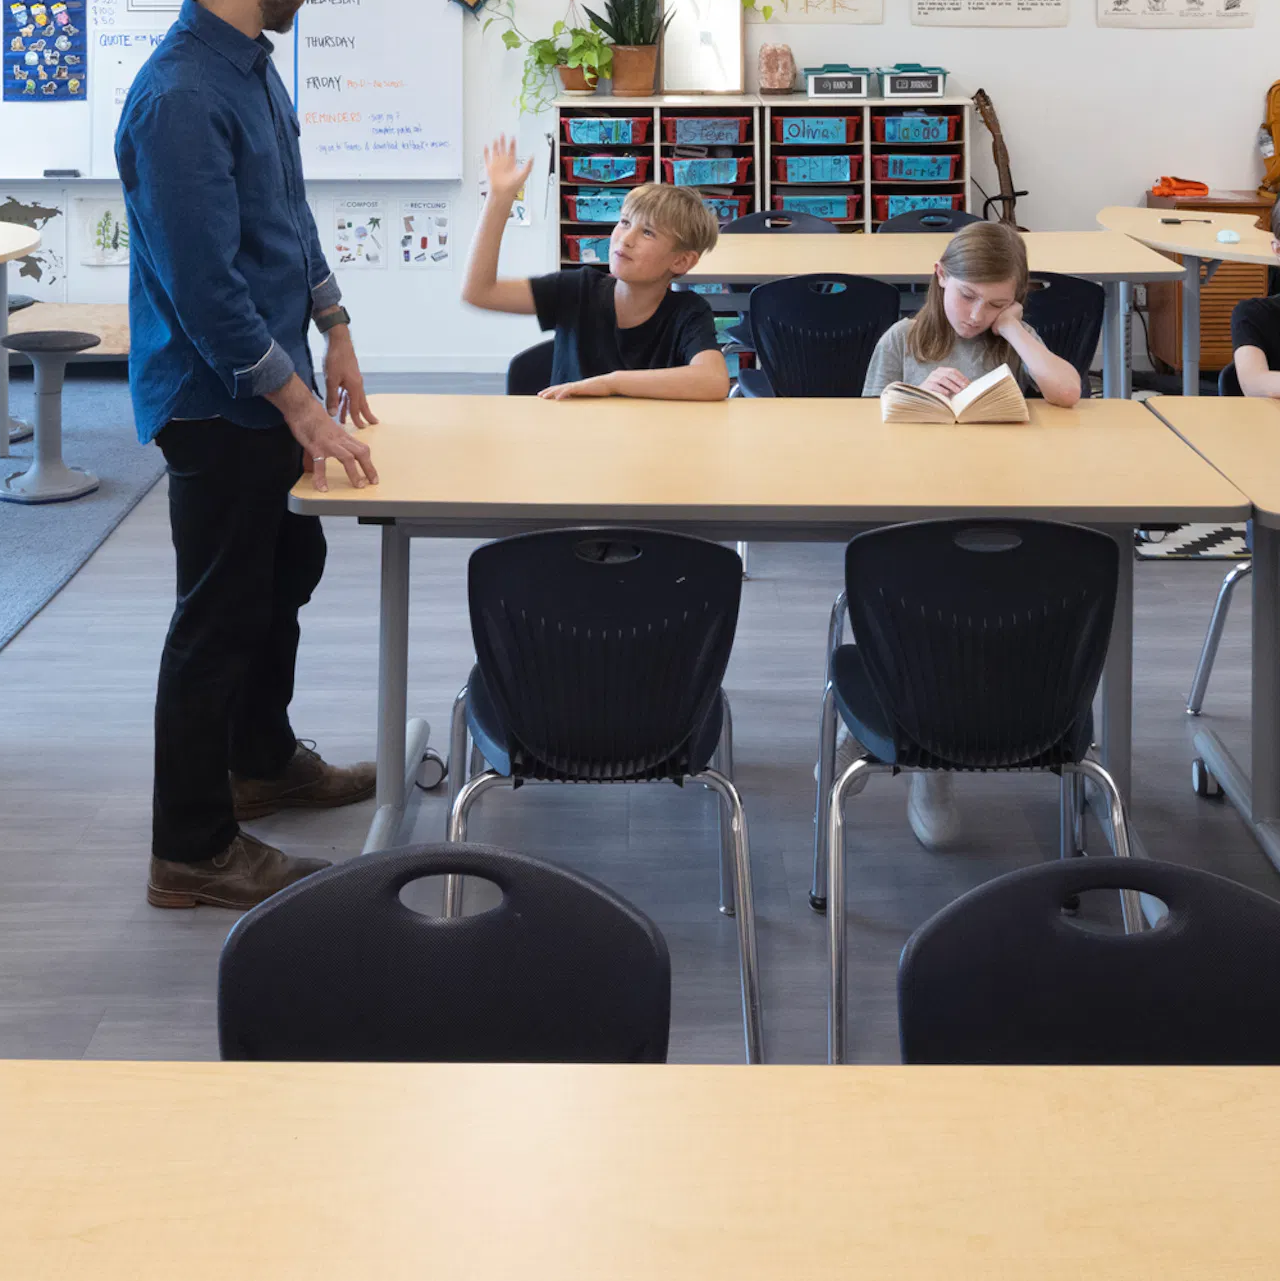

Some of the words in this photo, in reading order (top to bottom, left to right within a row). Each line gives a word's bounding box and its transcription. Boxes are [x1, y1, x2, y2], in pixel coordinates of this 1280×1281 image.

[100, 33, 132, 46] QUOTE
[305, 36, 356, 49] THURSDAY
[306, 75, 342, 92] FRIDAY
[832, 80, 853, 89] HAND-IN
[910, 80, 932, 88] JOURNALS
[305, 112, 361, 124] REMINDERS
[892, 160, 942, 175] Harriet
